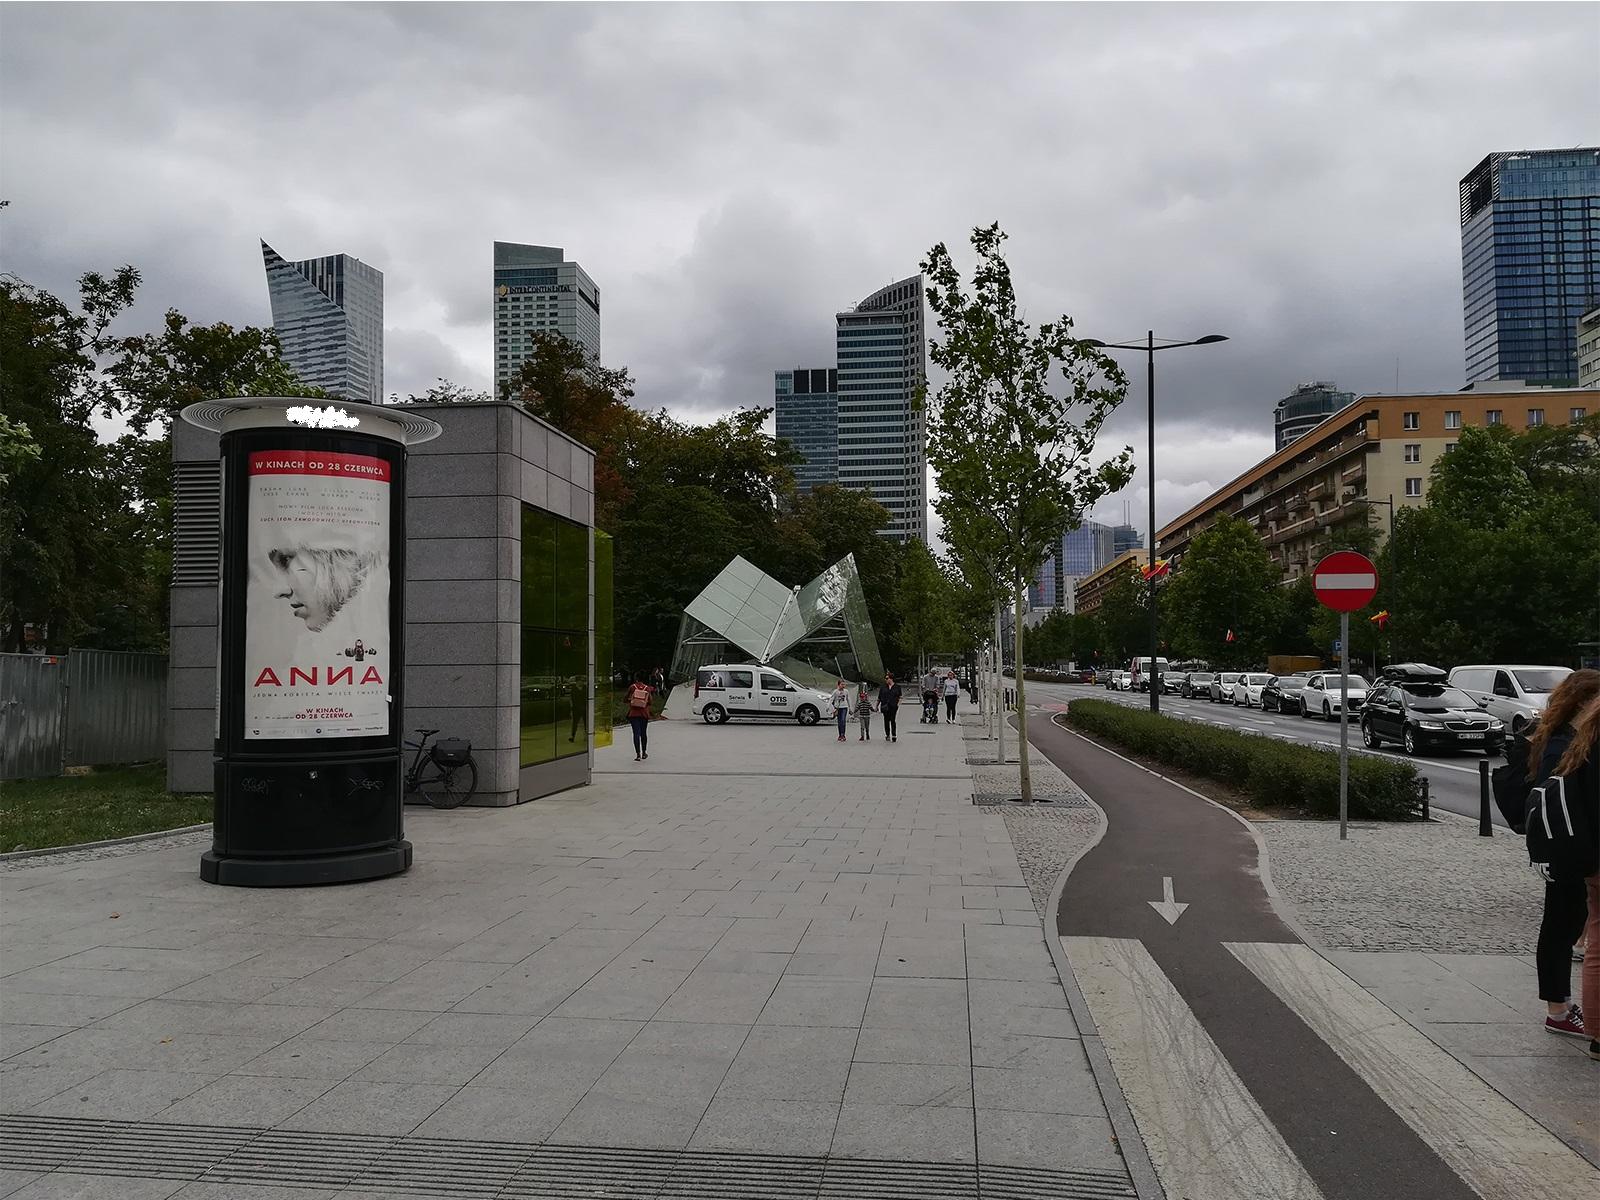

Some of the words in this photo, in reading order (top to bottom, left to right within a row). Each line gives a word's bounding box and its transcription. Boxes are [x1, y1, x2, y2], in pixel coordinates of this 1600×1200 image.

[255, 461, 264, 469] W
[266, 461, 305, 469] KINACH
[308, 461, 324, 470] OD
[328, 462, 341, 470] 28
[344, 464, 384, 475] CZERWCA
